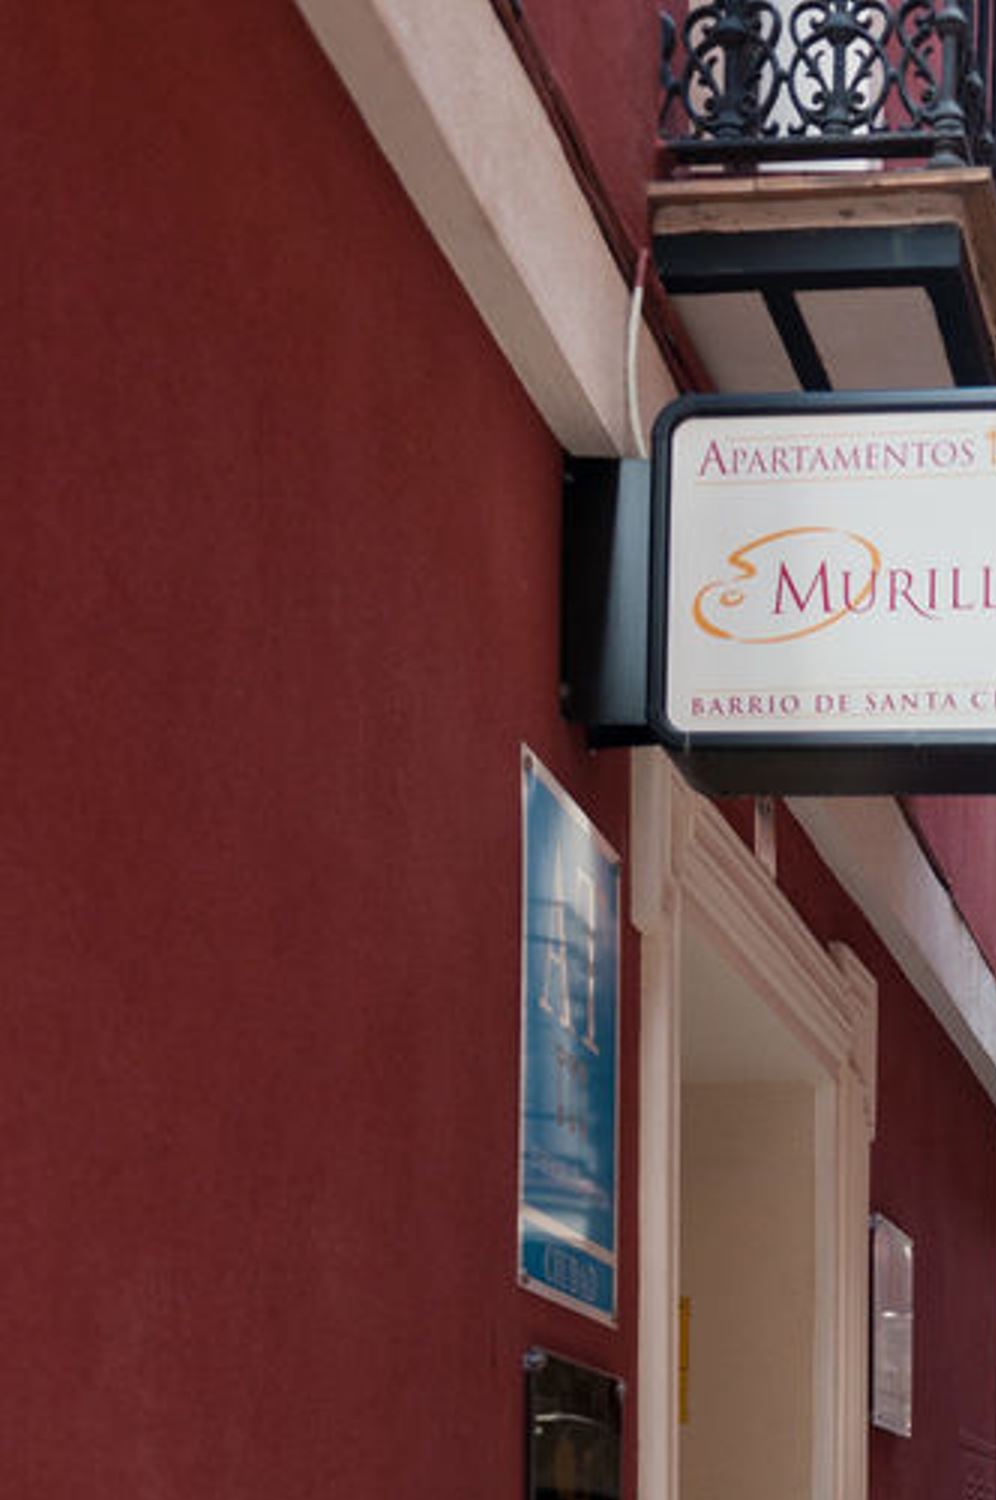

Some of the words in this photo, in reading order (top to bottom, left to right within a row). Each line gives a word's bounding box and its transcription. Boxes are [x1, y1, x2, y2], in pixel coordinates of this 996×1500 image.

[698, 438, 975, 477] APARTAMENTOS
[690, 694, 800, 717] BARRIO
[814, 693, 850, 714] DE
[865, 689, 958, 713] SANTA
